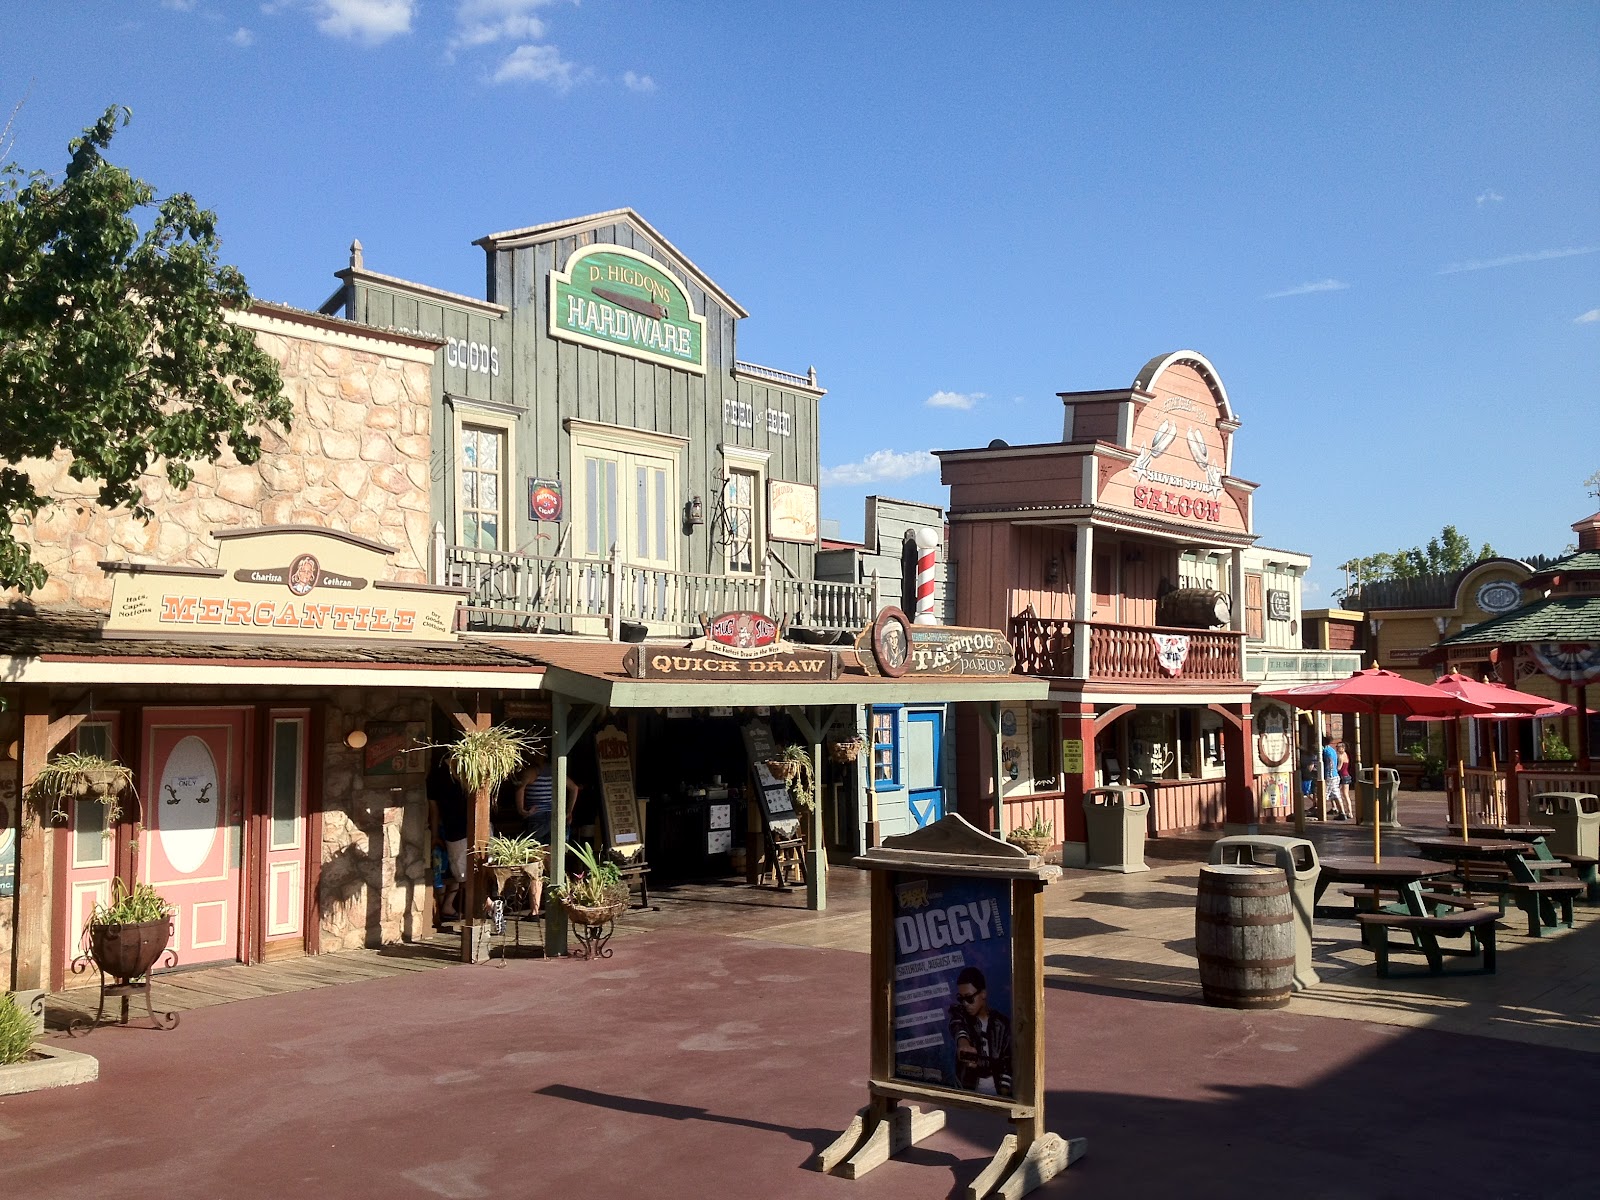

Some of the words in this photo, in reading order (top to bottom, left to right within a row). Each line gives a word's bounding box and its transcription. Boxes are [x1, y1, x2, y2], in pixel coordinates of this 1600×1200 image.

[589, 265, 603, 281] D.
[608, 266, 671, 303] HIGDONS
[567, 295, 692, 357] HARDWARE
[448, 336, 499, 377] GOODS
[1146, 470, 1183, 488] SILVER
[1184, 478, 1210, 493] SPUR
[538, 506, 555, 515] CIGAR
[1134, 485, 1221, 522] SALOON
[251, 572, 283, 583] Charissa
[118, 608, 152, 617] Notions
[159, 594, 416, 632] MERCANTILE
[713, 617, 735, 637] MUG
[651, 655, 741, 673] QUICK
[748, 659, 825, 673] DRAW
[912, 634, 994, 671] TATTOO
[896, 899, 991, 955] DIGGY
